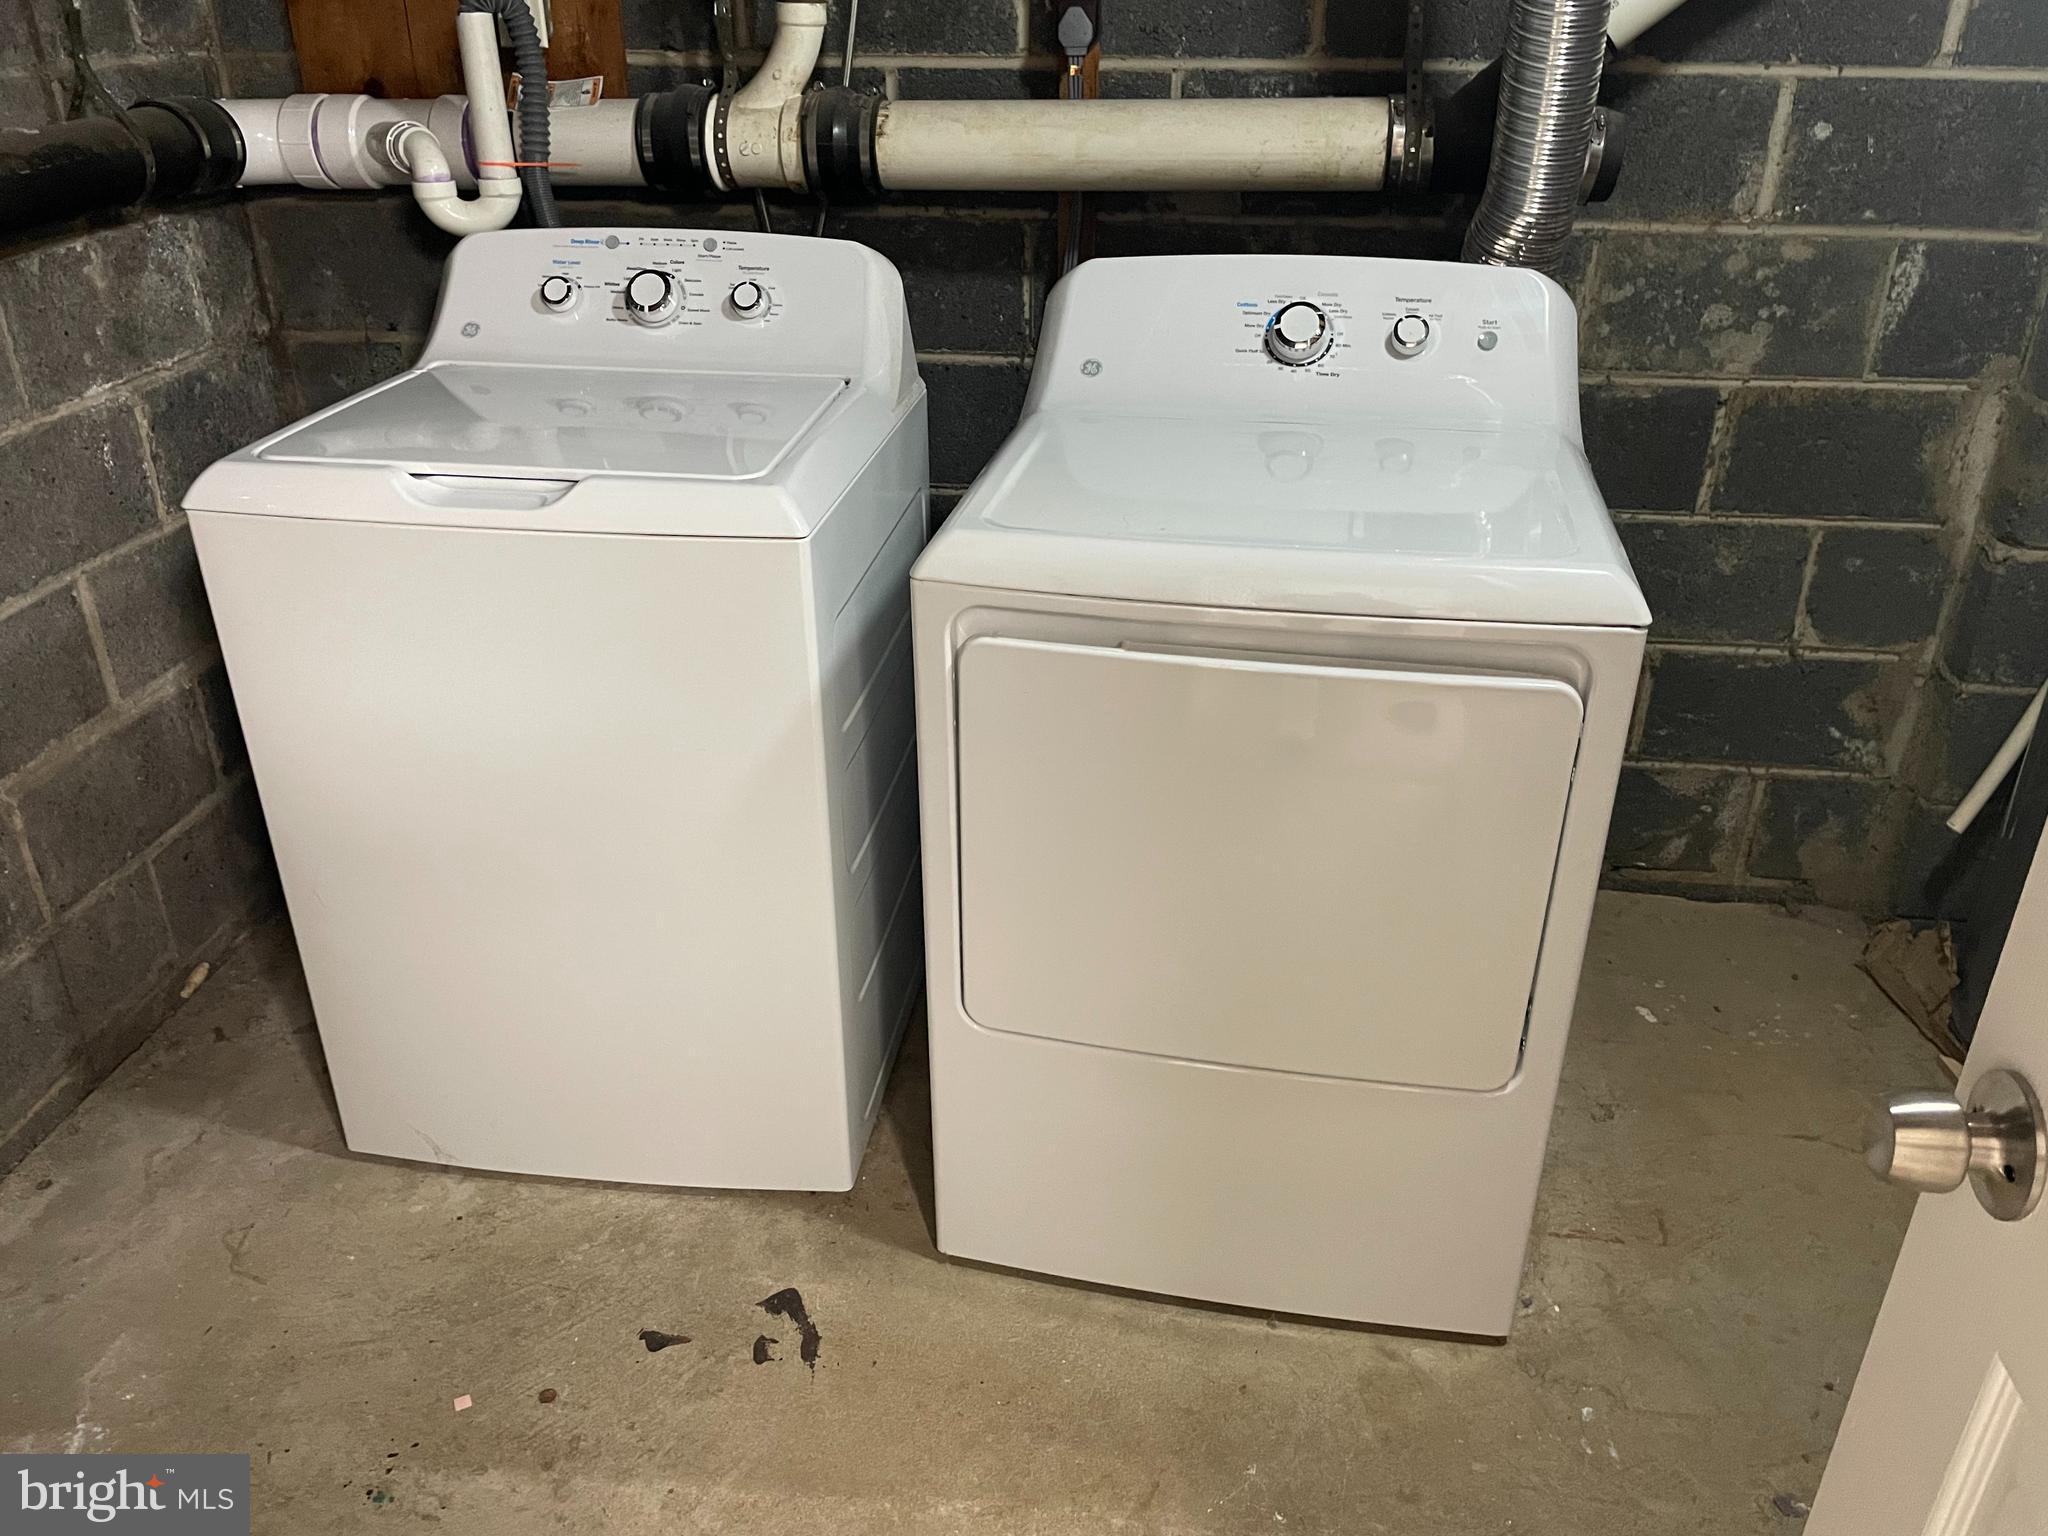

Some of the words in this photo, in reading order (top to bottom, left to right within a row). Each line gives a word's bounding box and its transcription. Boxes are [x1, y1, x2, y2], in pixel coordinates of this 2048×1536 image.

[1395, 296, 1432, 304] Temperature
[461, 322, 480, 338] GE
[1081, 359, 1102, 377] GE
